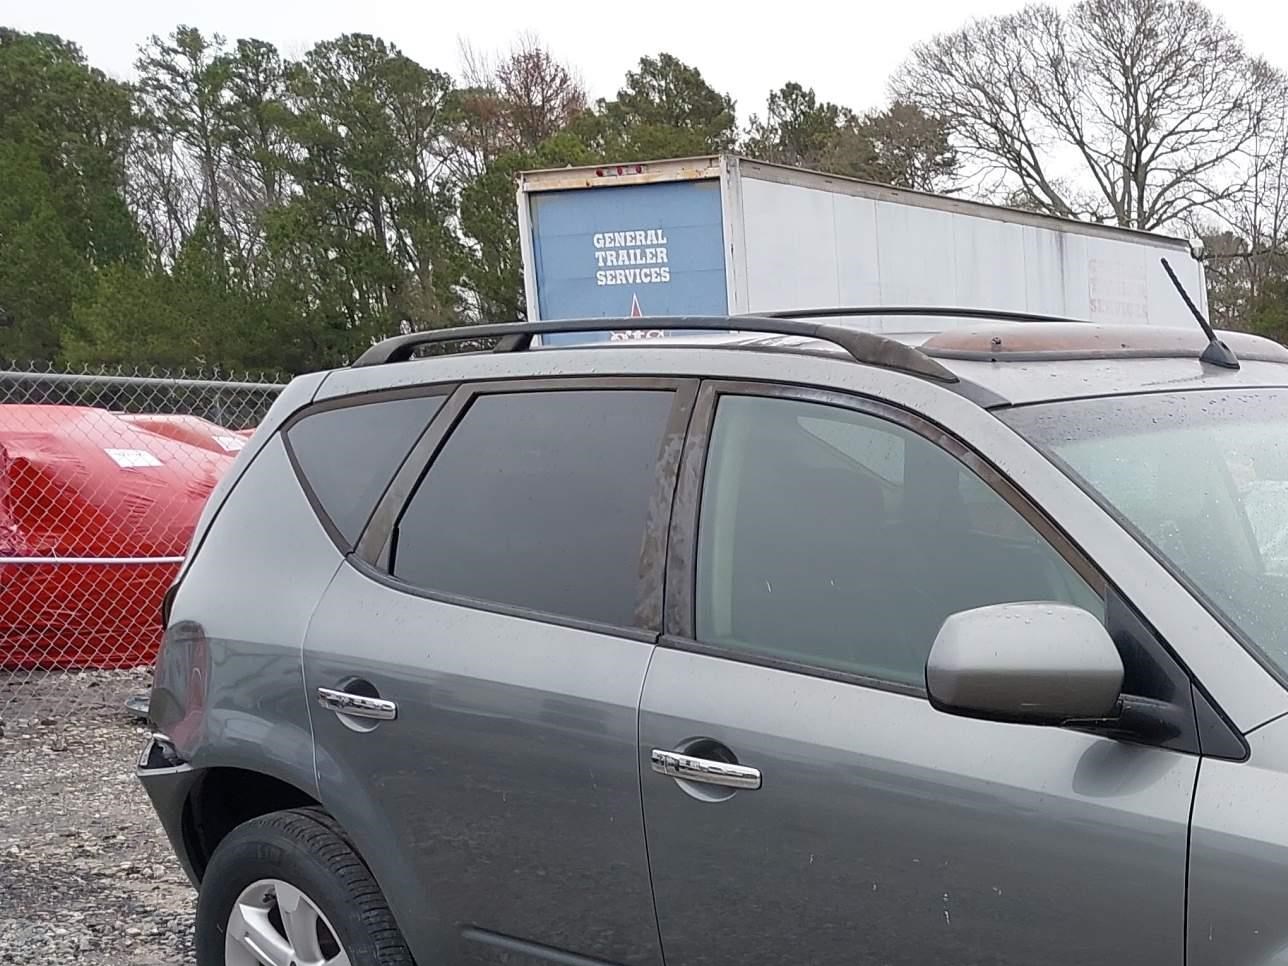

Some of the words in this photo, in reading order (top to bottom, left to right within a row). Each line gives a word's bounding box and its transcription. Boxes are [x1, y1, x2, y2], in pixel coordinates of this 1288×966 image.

[593, 229, 667, 248] GENERAL
[595, 247, 668, 267] TRAILER
[596, 266, 670, 286] SERVICES
